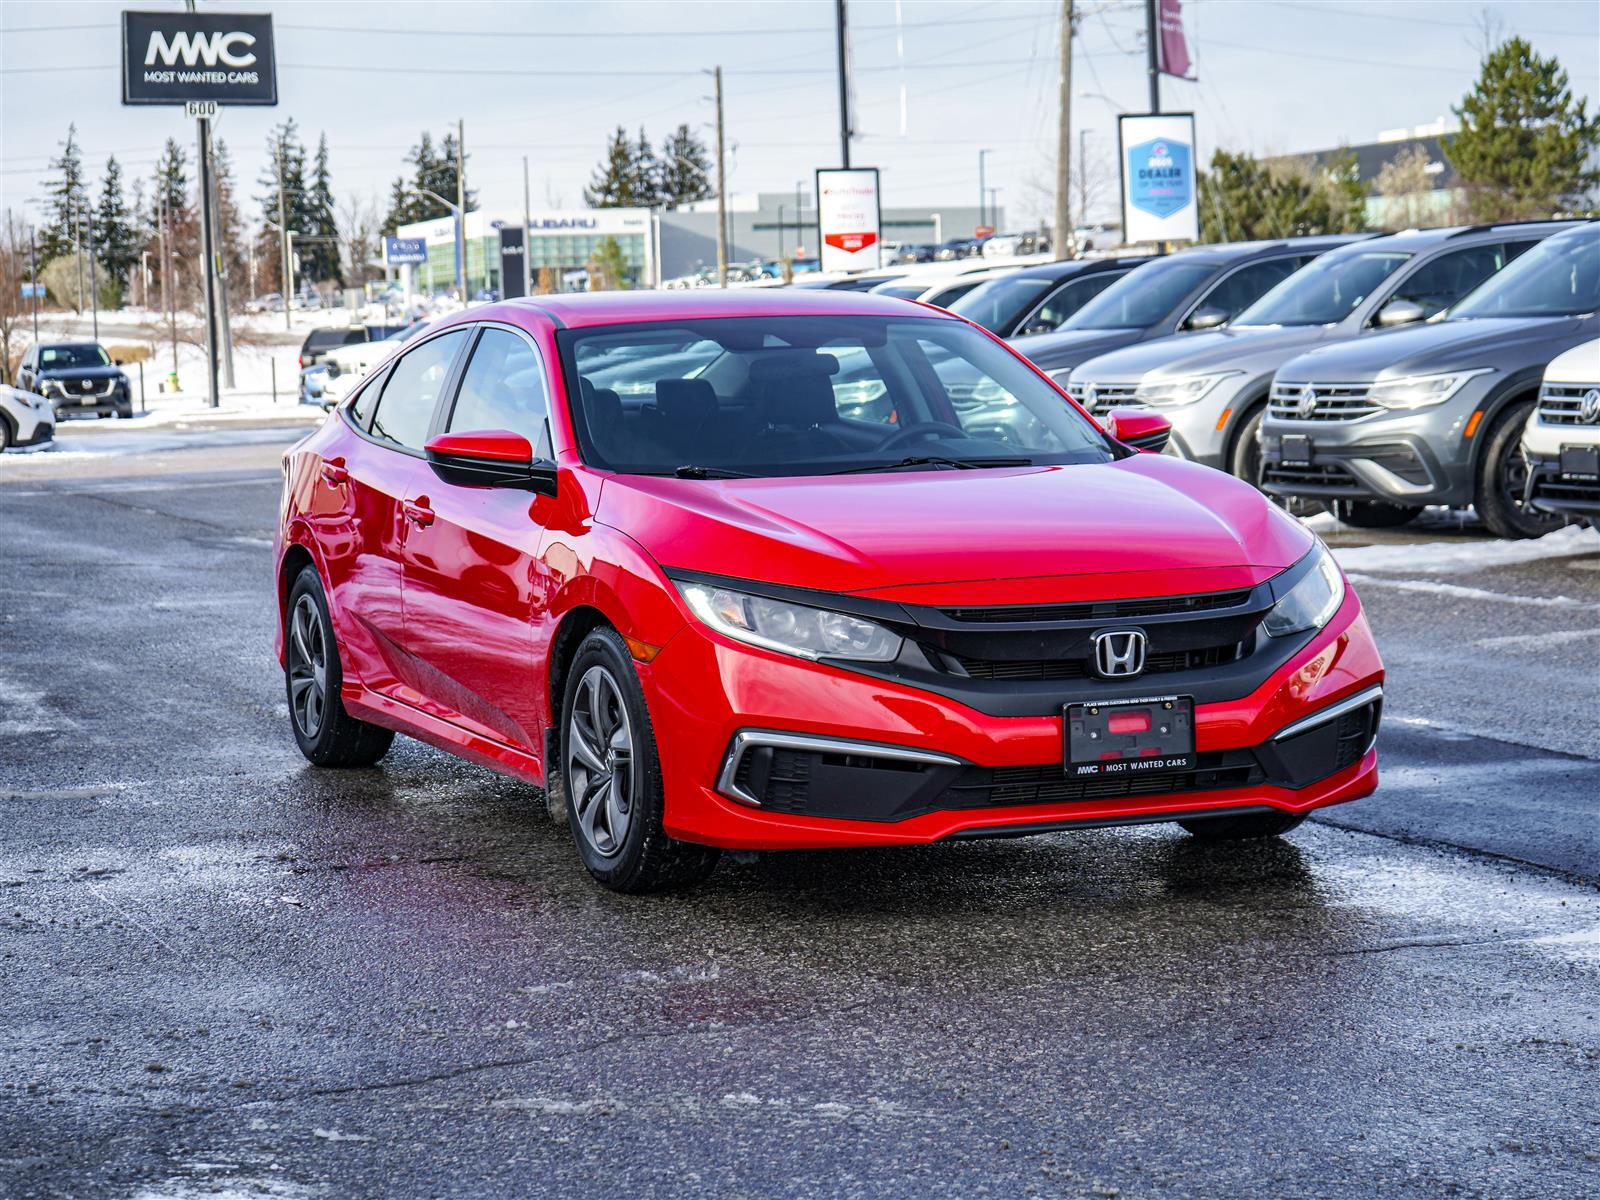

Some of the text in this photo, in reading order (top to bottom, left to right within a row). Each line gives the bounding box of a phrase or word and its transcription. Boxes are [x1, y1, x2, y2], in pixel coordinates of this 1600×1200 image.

[144, 30, 257, 68] MWC
[144, 71, 259, 84] MOST WANTED CARS
[189, 103, 215, 115] 600
[1138, 168, 1181, 179] DEALER
[1077, 758, 1187, 775] MWC MOST WANTED CARS
